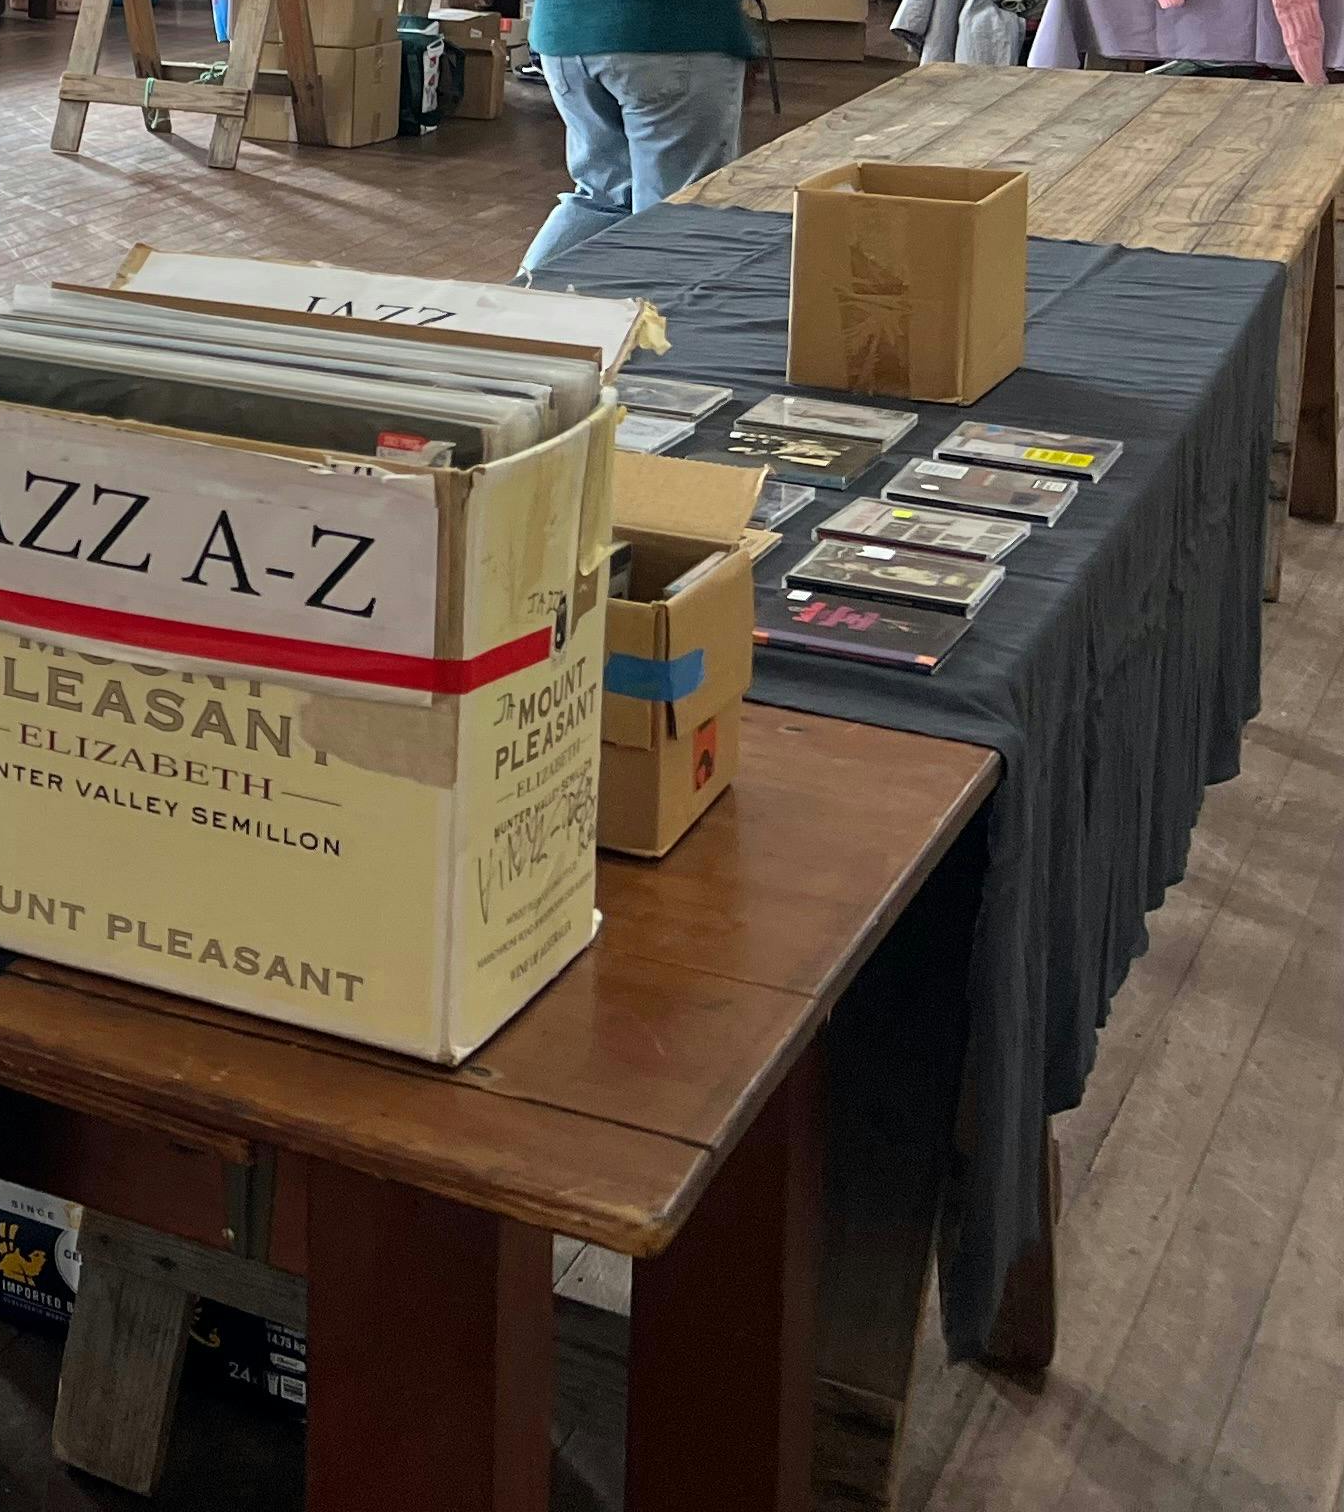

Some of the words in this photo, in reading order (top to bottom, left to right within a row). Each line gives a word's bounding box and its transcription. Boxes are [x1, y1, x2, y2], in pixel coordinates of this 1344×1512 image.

[181, 509, 377, 618] A-Z
[495, 682, 598, 781] PLEASANT
[518, 656, 587, 730] MOUNT
[16, 721, 274, 801] ELIZABETH
[75, 778, 178, 818] VALLEY
[191, 805, 342, 857] SEMILLON
[106, 911, 366, 1003] PLEASANT
[11, 1199, 55, 1221] SINCE
[2, 1279, 61, 1309] IMPORTED
[228, 1361, 250, 1383] 24
